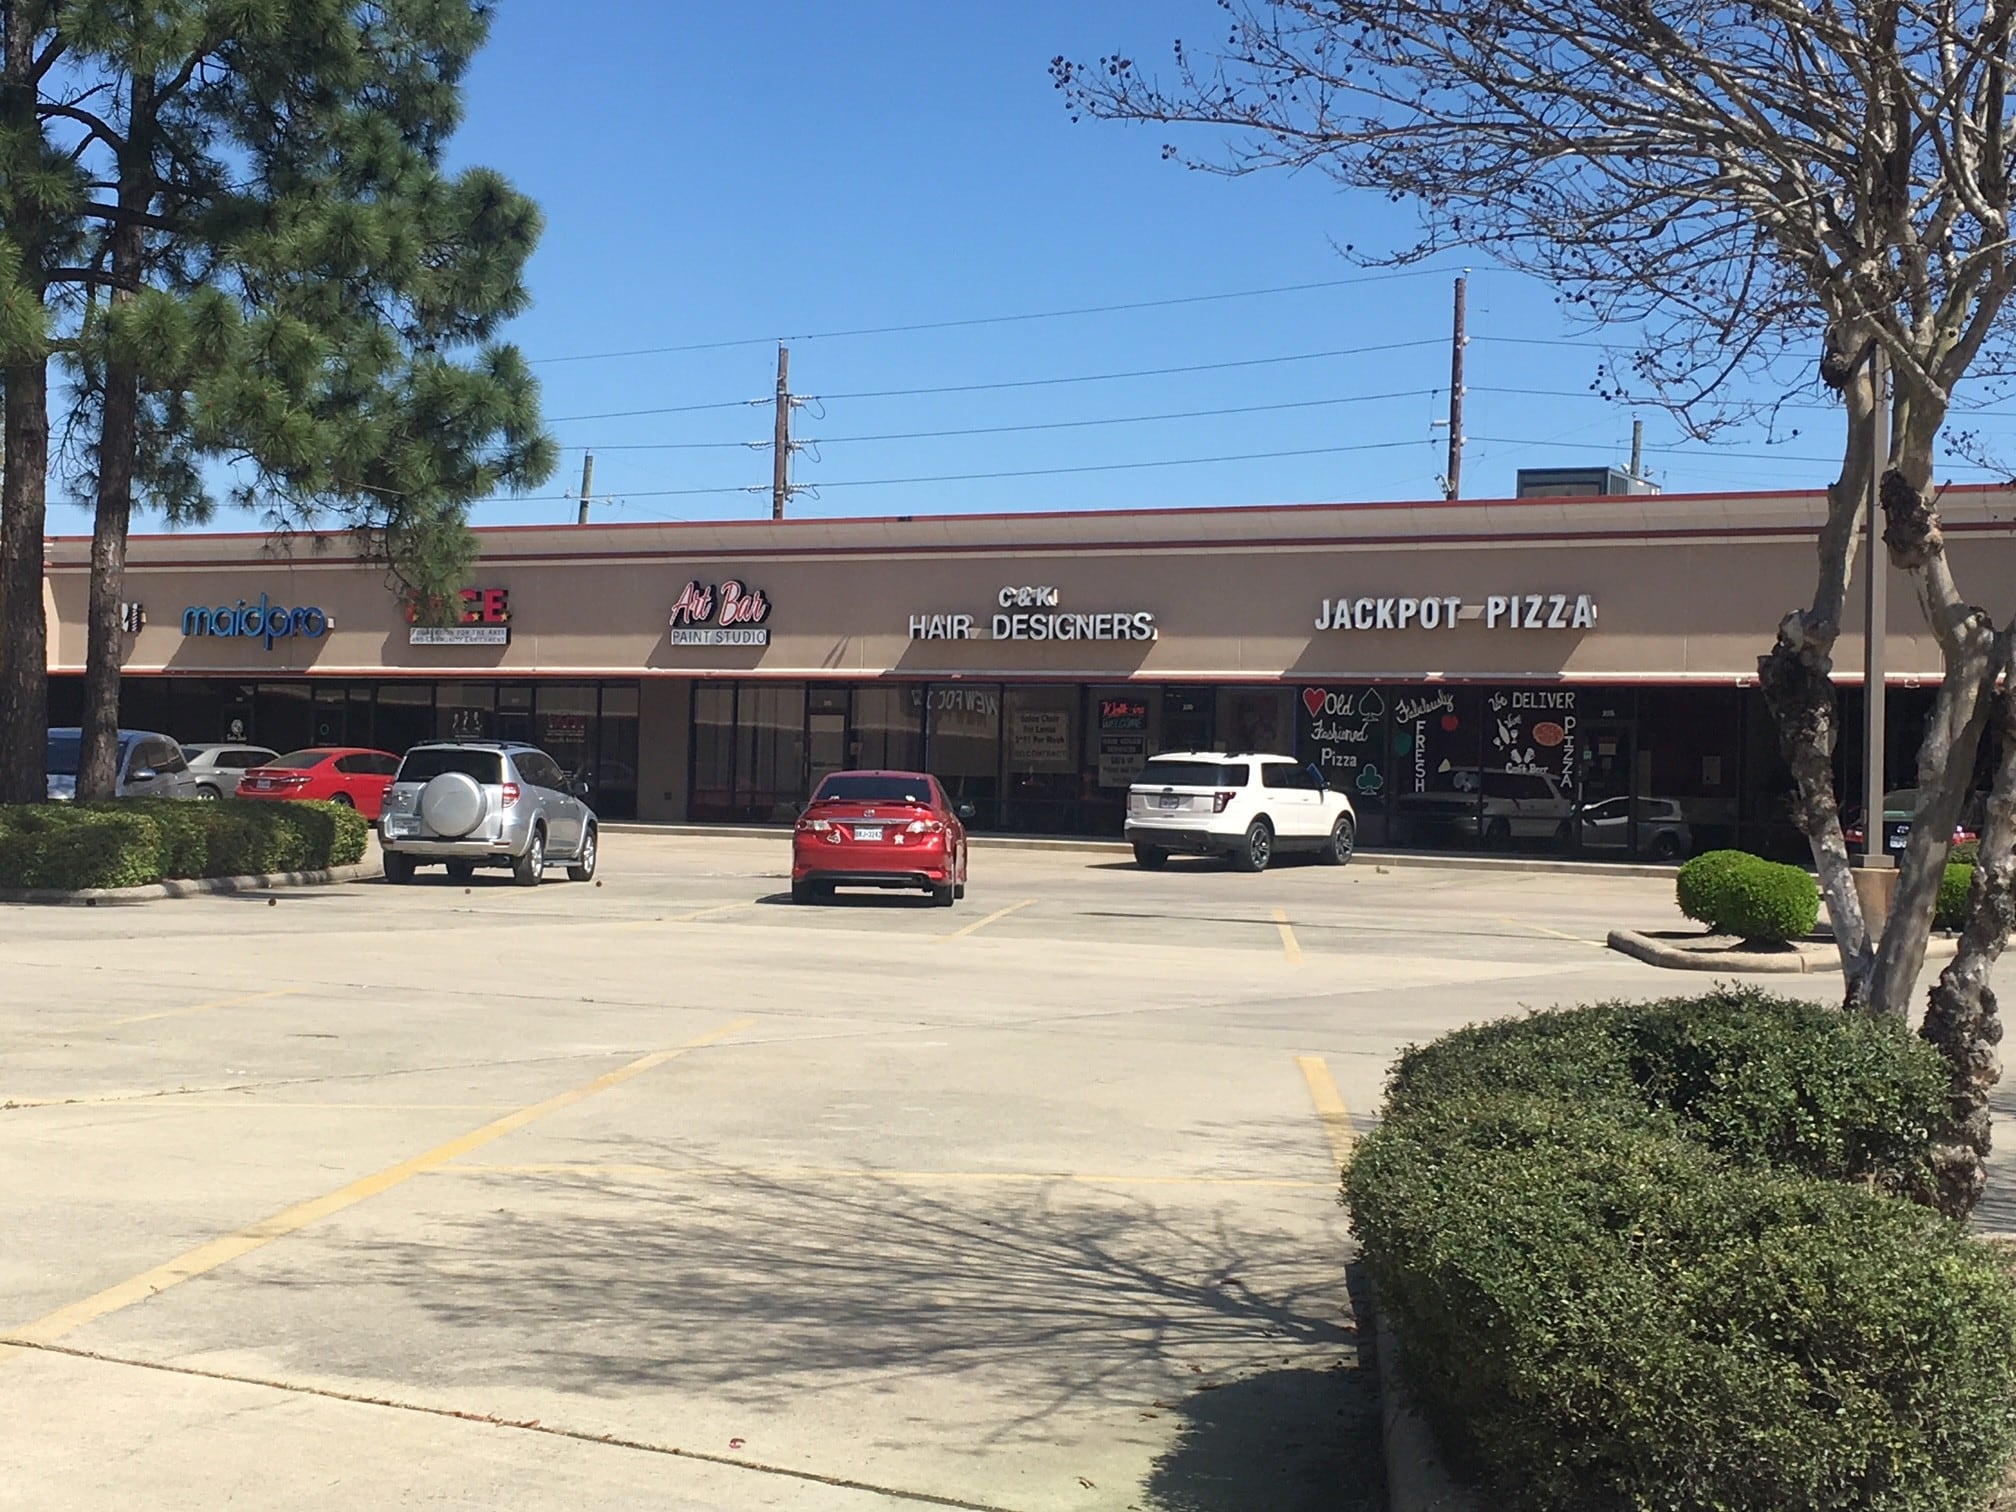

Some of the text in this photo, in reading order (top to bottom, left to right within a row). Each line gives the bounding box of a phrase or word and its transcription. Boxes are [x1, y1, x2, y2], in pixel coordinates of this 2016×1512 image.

[670, 581, 767, 626] Art Bar
[1315, 595, 1595, 630] JACKPOT PIZZA
[182, 592, 324, 650] maidpro
[909, 612, 1153, 641] HAIR DESIGNERS
[673, 631, 766, 643] PAINT STUDIO
[1324, 693, 1355, 716] Old
[1512, 692, 1576, 709] DELIVER
[1311, 719, 1369, 743] Fashioned
[1321, 747, 1357, 767] Pizza
[1415, 720, 1426, 792] FRESH
[1560, 716, 1577, 788] PIZZA
